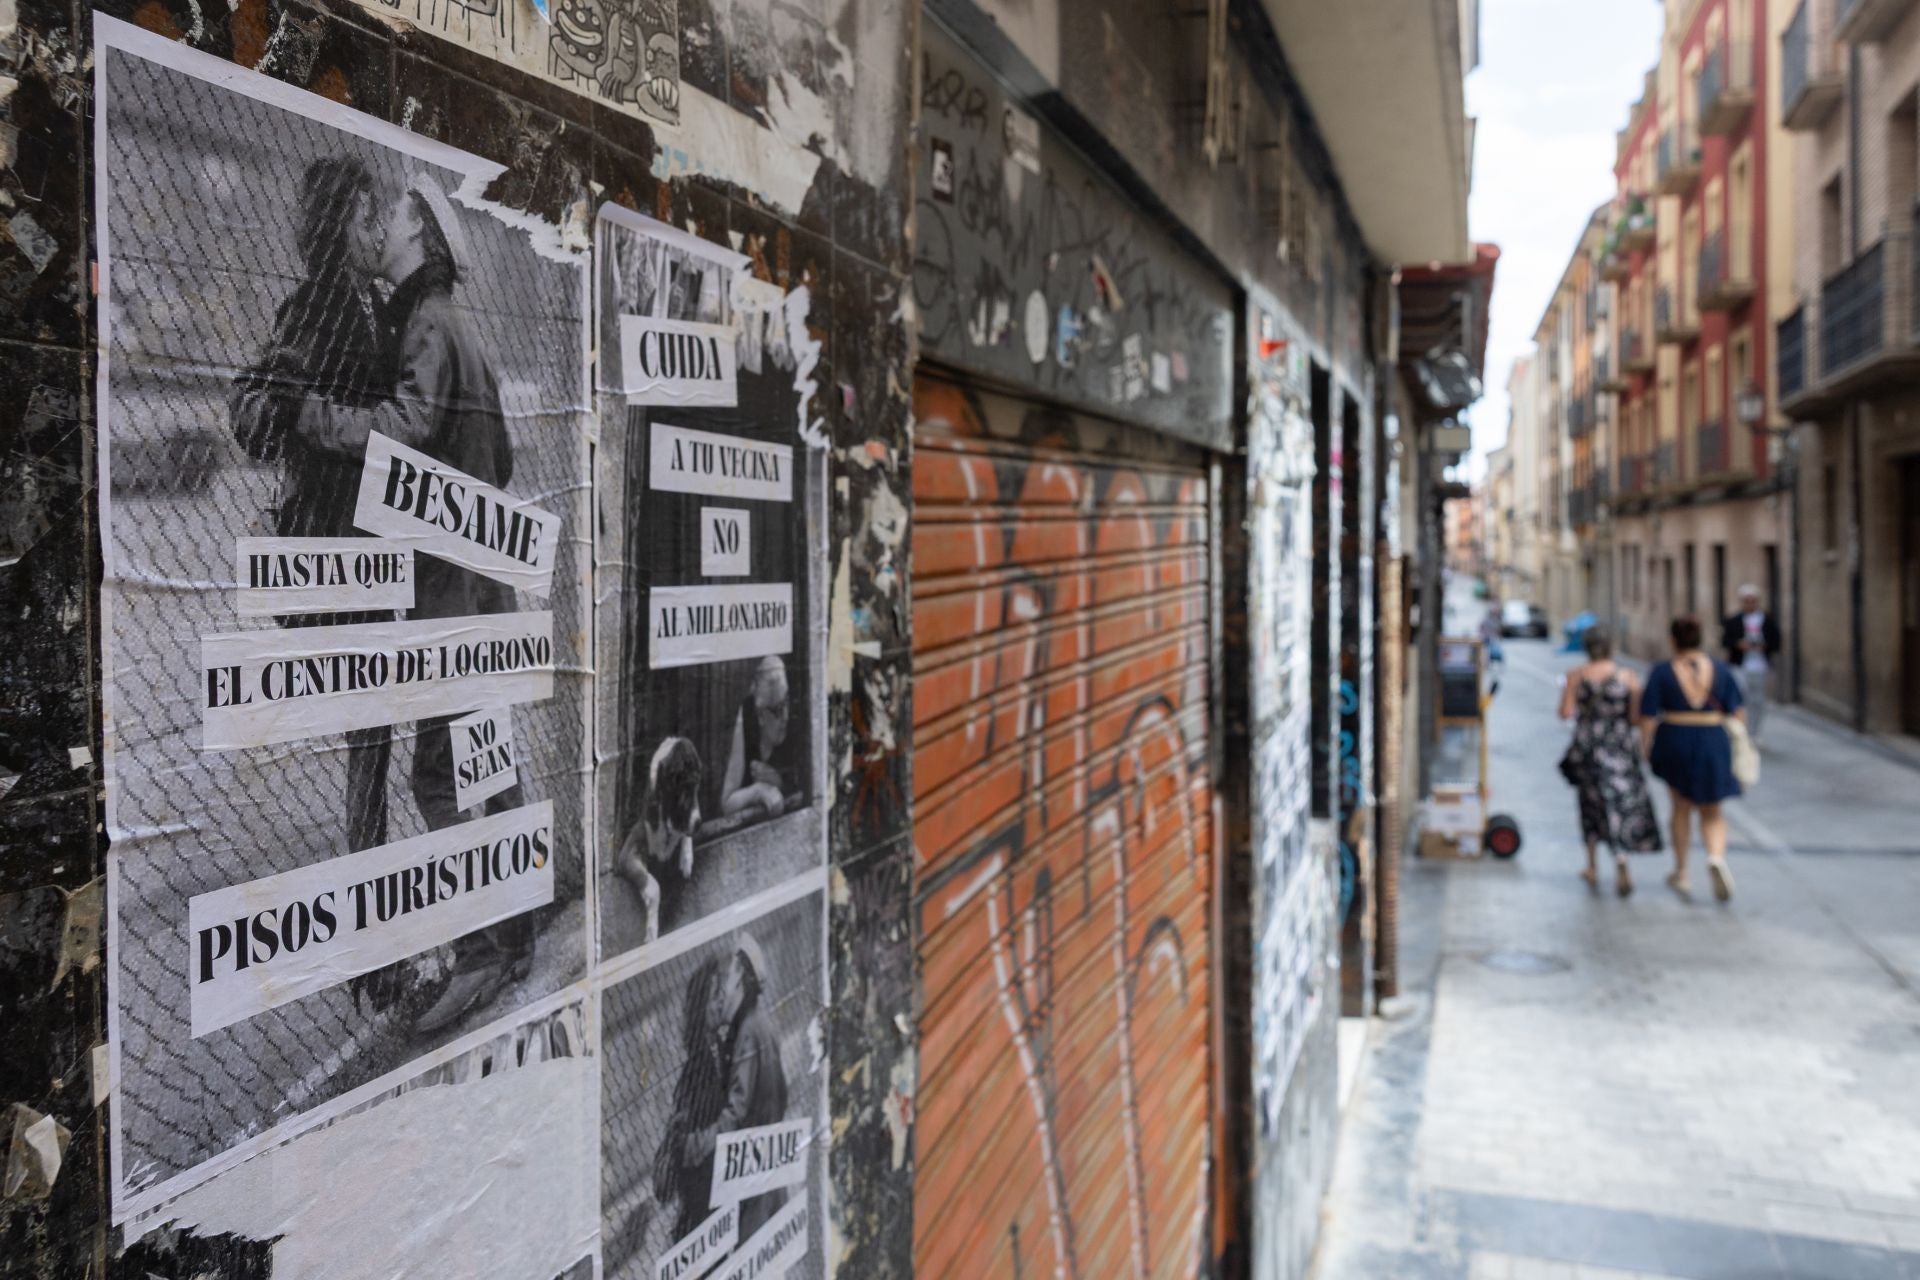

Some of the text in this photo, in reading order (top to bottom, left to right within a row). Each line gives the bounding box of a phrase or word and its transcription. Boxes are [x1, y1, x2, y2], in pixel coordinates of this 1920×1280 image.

[639, 330, 722, 380] CUIDA
[671, 438, 780, 482] A TU VECINA
[382, 455, 543, 567] BÉSAME
[713, 518, 740, 554] NO
[249, 552, 406, 590] HASTA QUE
[657, 601, 787, 639] AL MILLONARIO
[207, 632, 551, 708] EL CENTRO DE LOGROÑO
[467, 718, 496, 754] NO
[458, 742, 514, 789] SEAN
[198, 827, 549, 984] PISOS TURÍSTICOS
[709, 1208, 735, 1247] QUE
